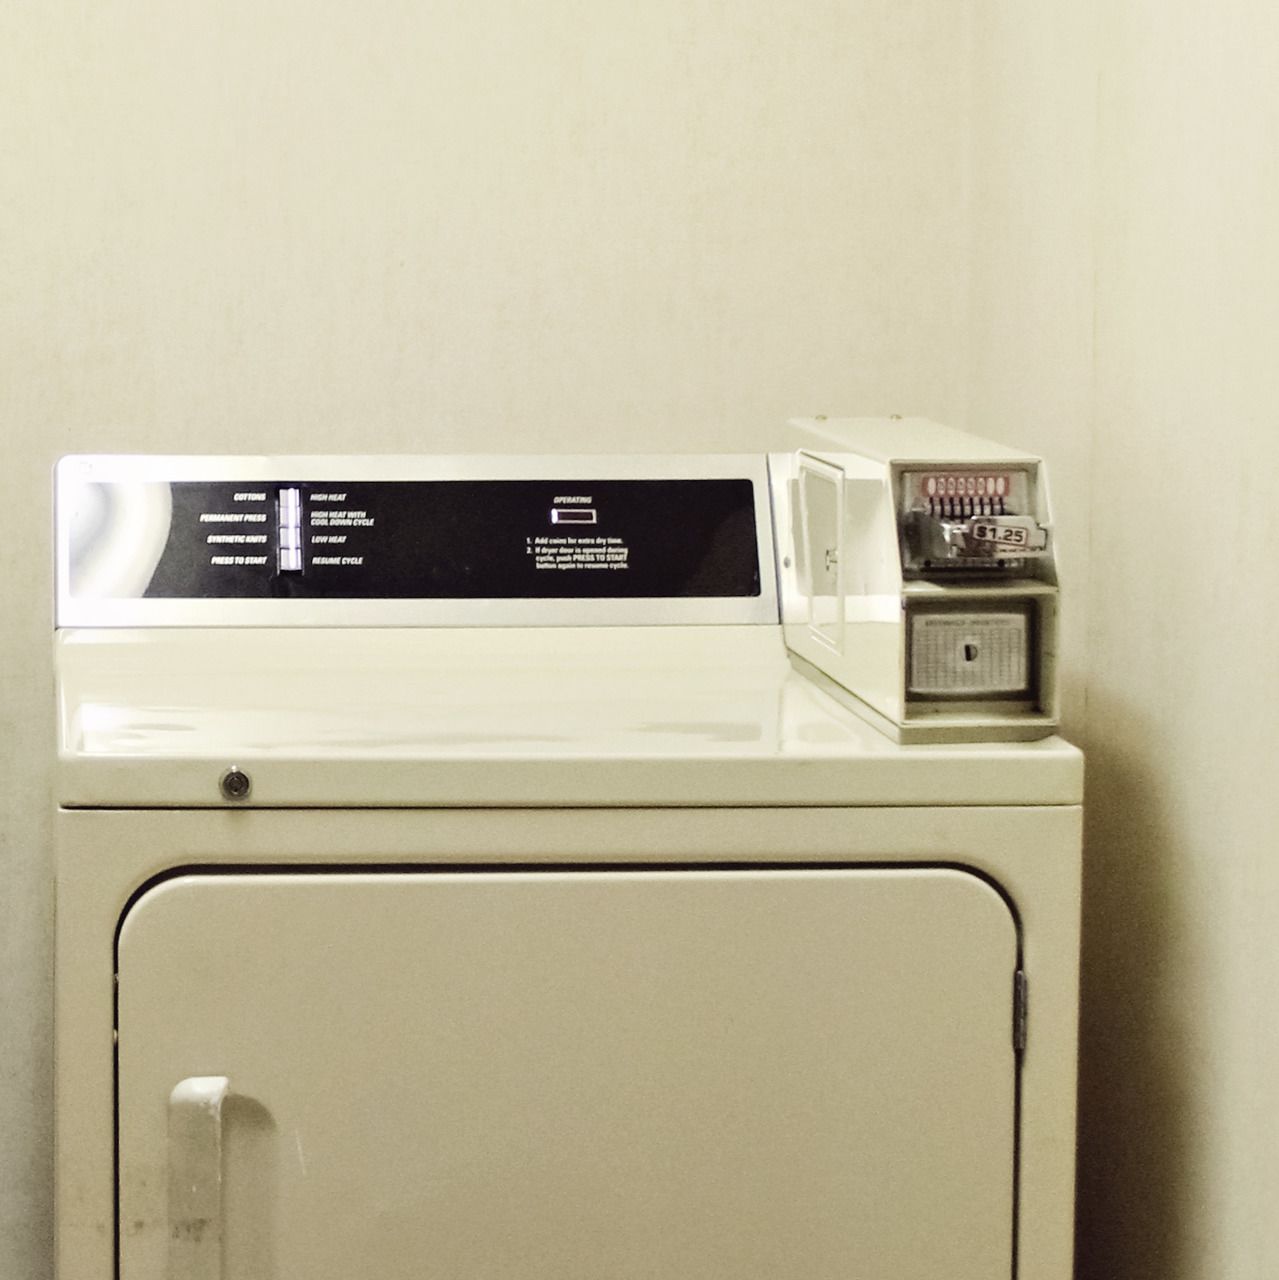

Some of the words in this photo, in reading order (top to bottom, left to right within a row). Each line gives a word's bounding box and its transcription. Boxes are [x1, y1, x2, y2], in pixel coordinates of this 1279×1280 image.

[233, 492, 267, 502] COTTONS
[310, 493, 328, 502] HIGH
[328, 493, 347, 502] HEAT
[553, 496, 593, 504] OPERATING
[199, 513, 244, 523] PERMANENT
[243, 513, 267, 523] PRESS
[310, 510, 328, 518] HIGH
[328, 510, 347, 518] HEAT
[347, 510, 367, 518] WITH
[310, 518, 329, 526] COOL
[329, 518, 353, 526] DOWN
[353, 518, 375, 526] CYCLE
[206, 534, 246, 544] SYNTHETIC
[245, 534, 268, 544] KNITS
[976, 526, 1024, 543] $1.25
[311, 535, 329, 544] LOW
[328, 535, 347, 544] HEAT
[596, 537, 606, 546] dry
[541, 547, 558, 555] dryer
[582, 547, 606, 555] opened
[607, 548, 628, 556] during
[211, 556, 234, 565] PRESS
[234, 556, 245, 565] TO
[244, 556, 268, 565] START
[312, 556, 341, 565] RESUME
[341, 556, 363, 565] CYCLE
[556, 555, 572, 563] push
[606, 554, 628, 562] START
[558, 562, 575, 570] again
